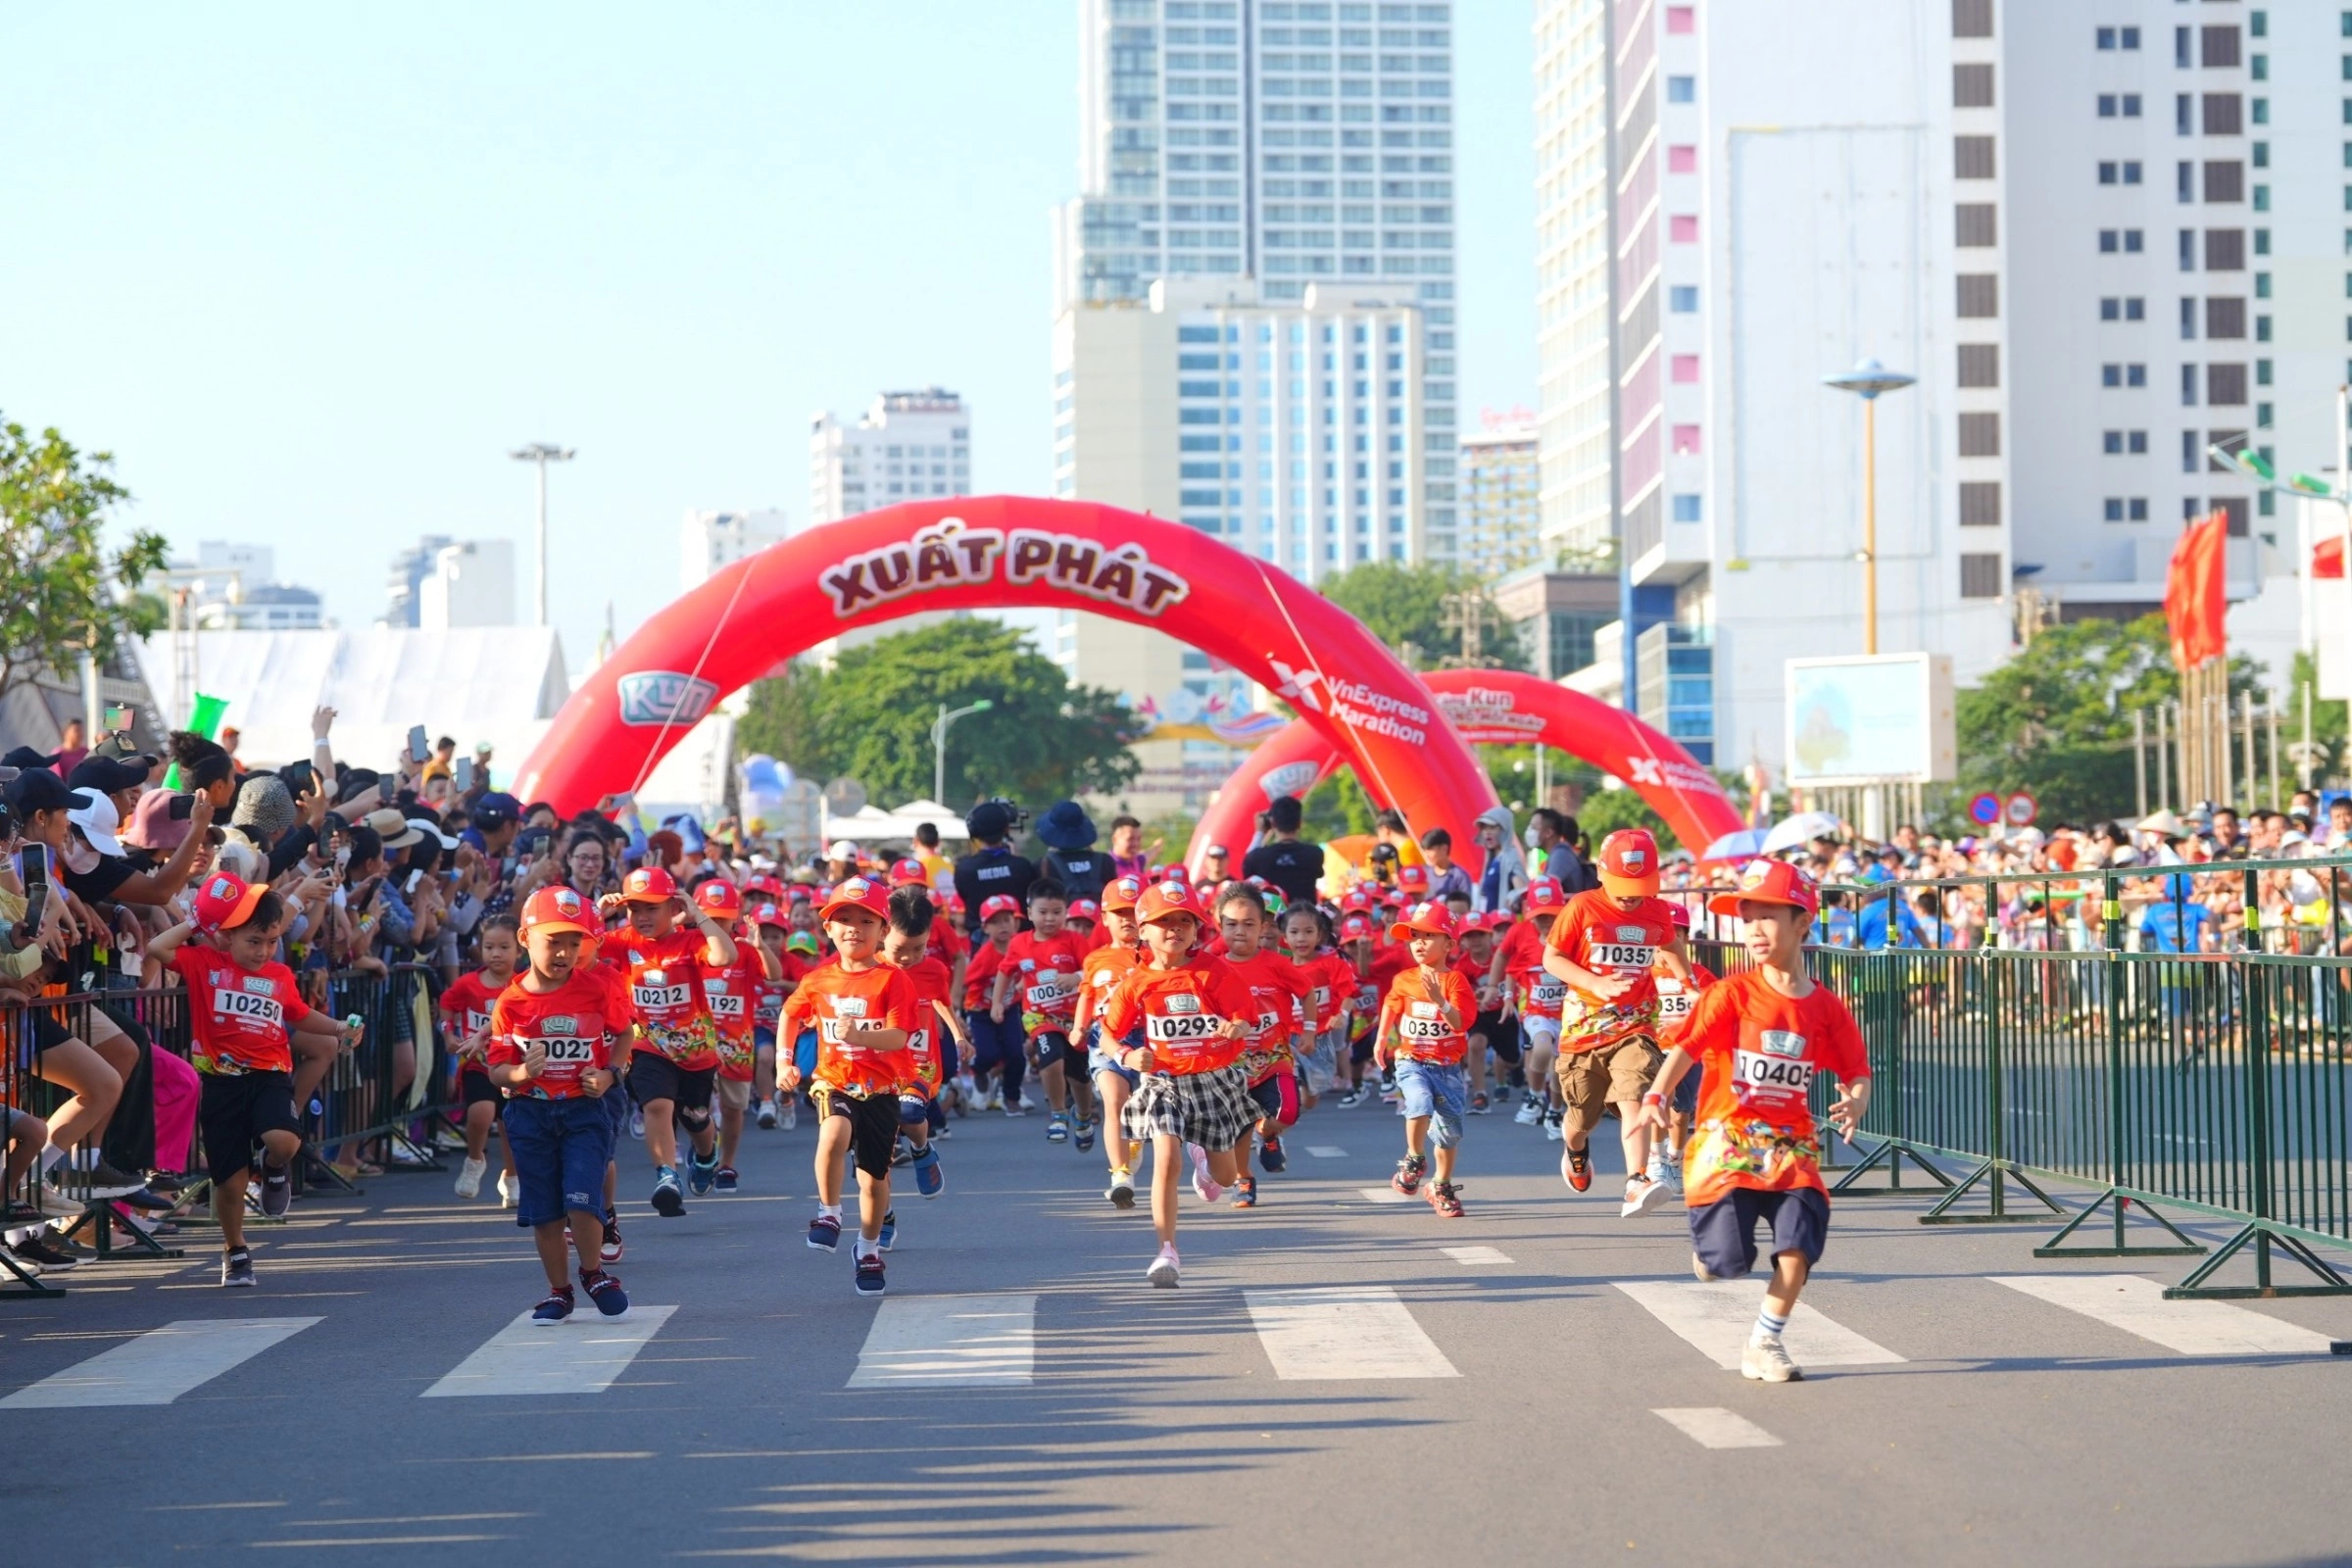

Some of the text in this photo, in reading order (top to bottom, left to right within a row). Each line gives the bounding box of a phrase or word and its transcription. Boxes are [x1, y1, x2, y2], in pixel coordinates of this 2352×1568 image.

[826, 523, 1182, 612] XUẤT PHÁT
[1328, 675, 1429, 724] VnExpress
[1329, 700, 1426, 746] Marathon
[977, 865, 1011, 880] MEDIA
[1600, 946, 1654, 964] 10357
[224, 993, 279, 1021] 10250
[633, 987, 683, 1005] 10212
[710, 996, 738, 1011] 192
[1152, 1016, 1219, 1038] 10293
[1407, 1019, 1451, 1037] 0339
[1740, 1054, 1813, 1089] 10405
